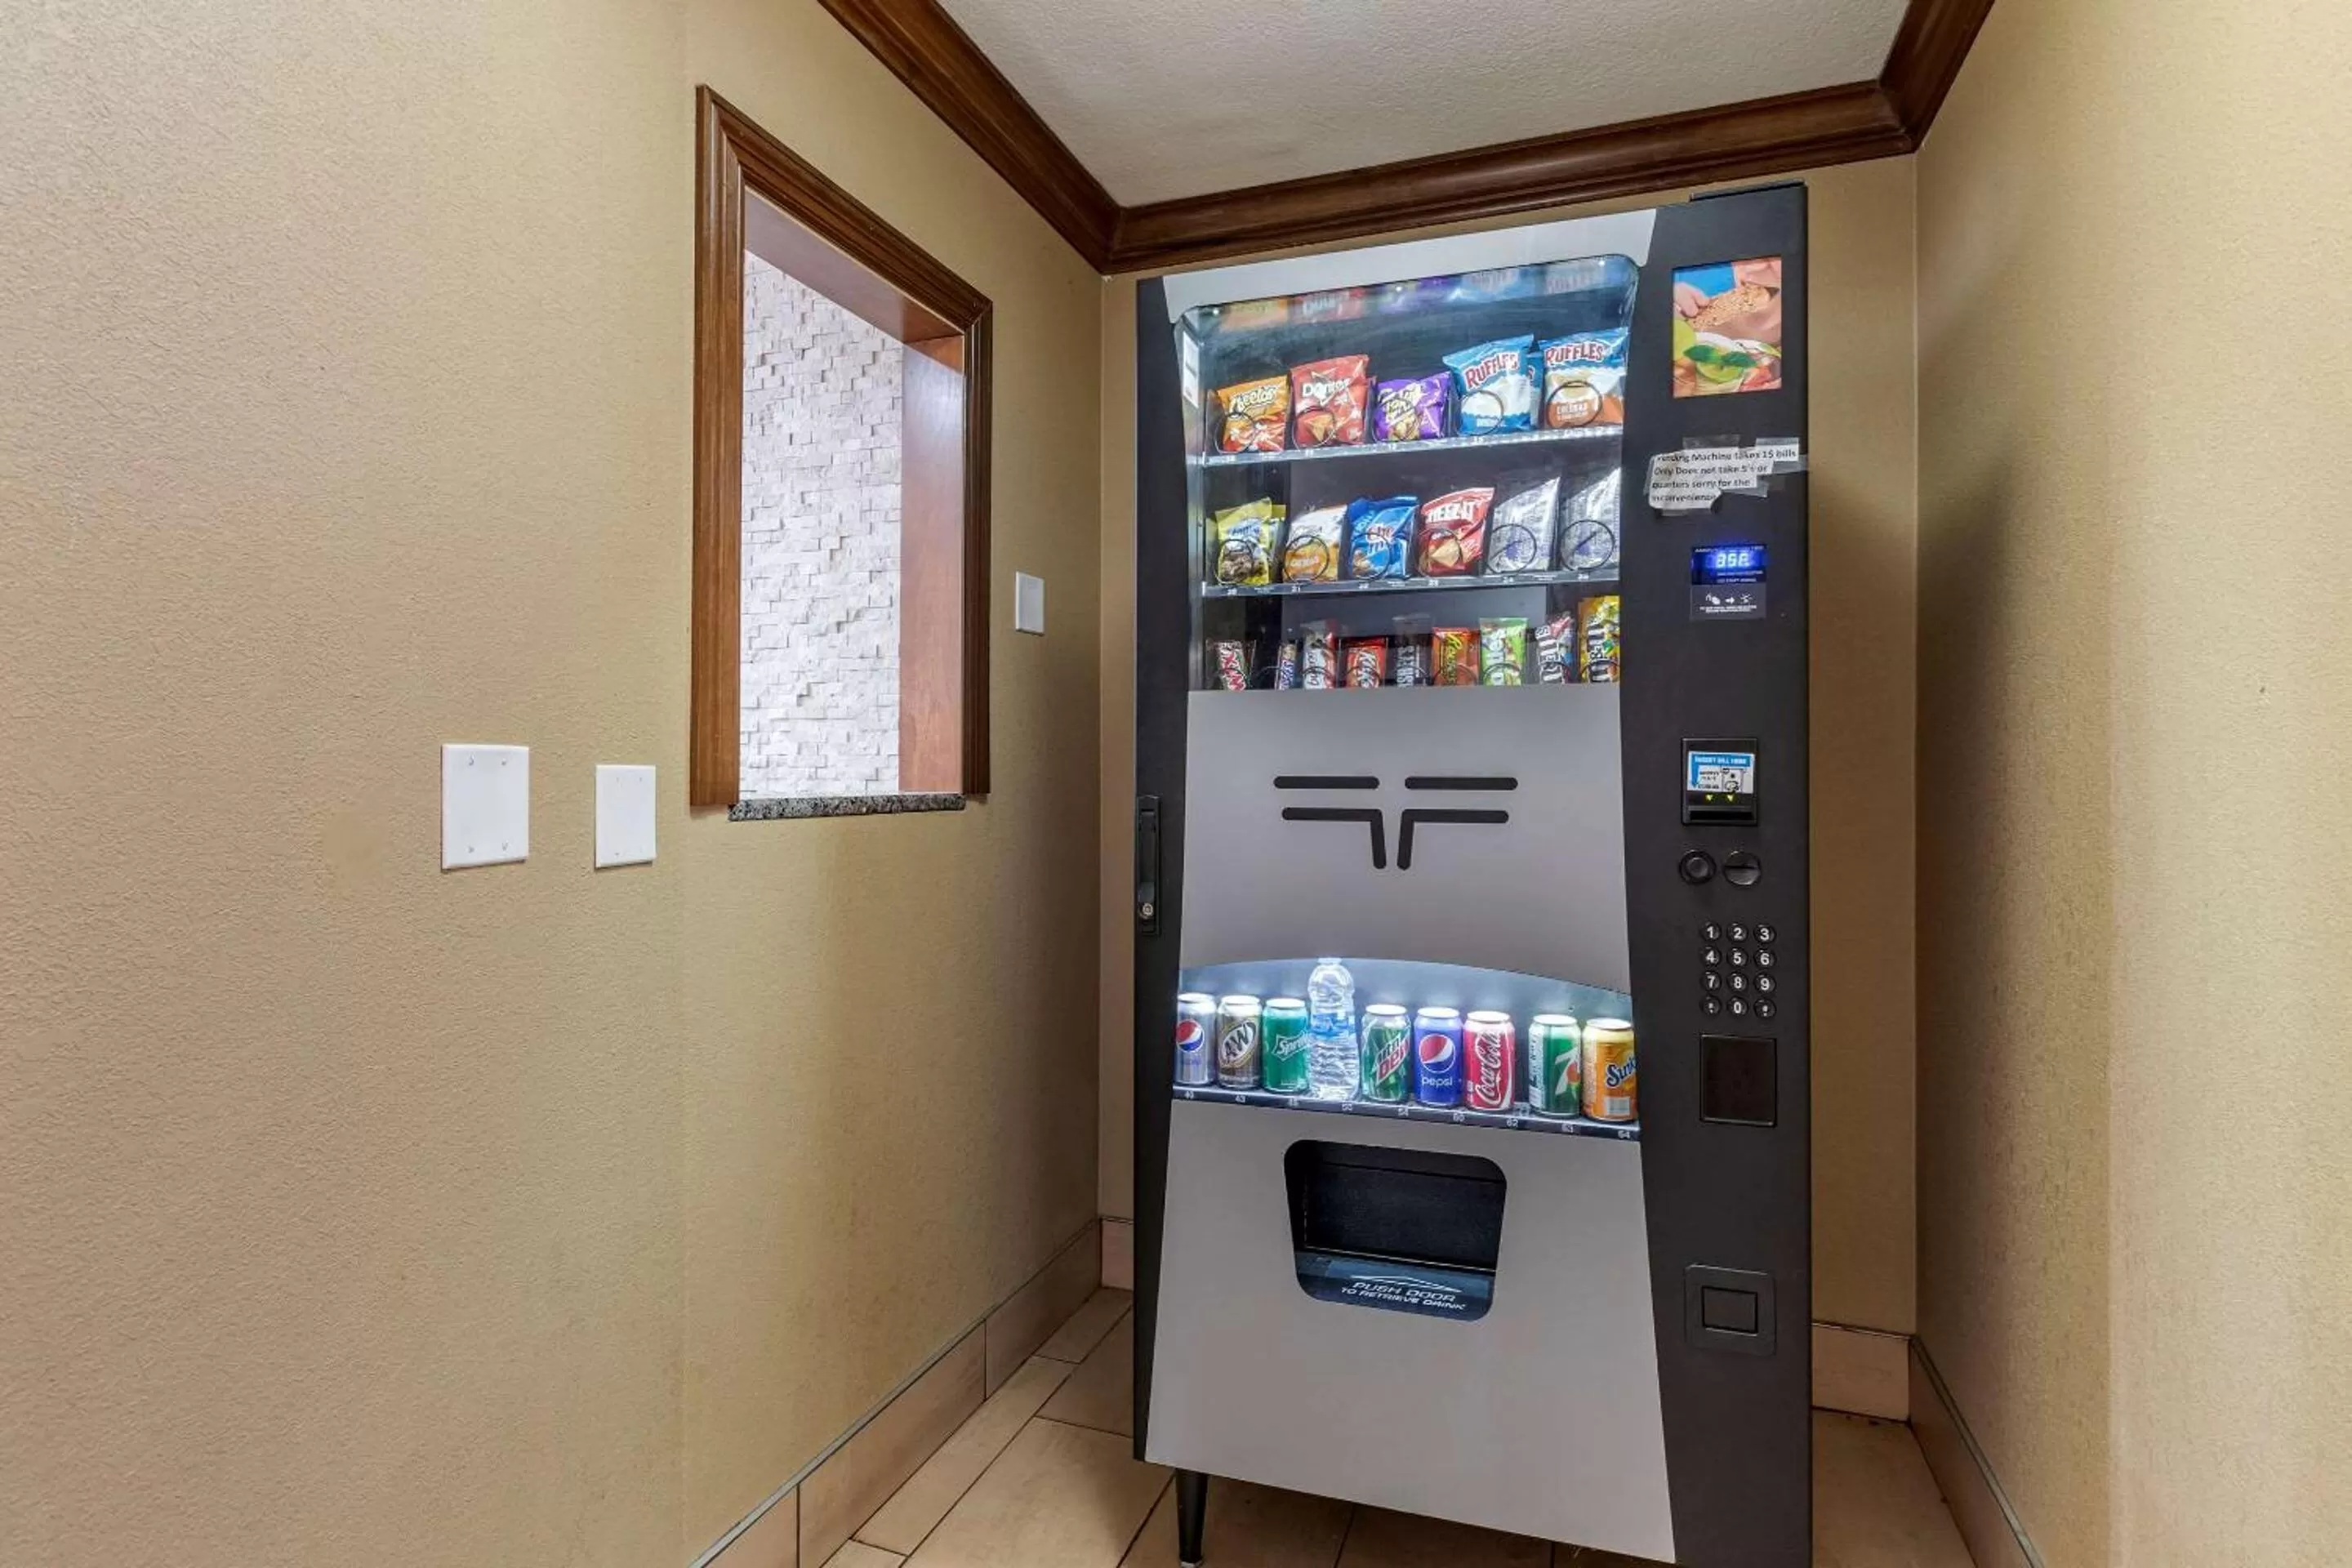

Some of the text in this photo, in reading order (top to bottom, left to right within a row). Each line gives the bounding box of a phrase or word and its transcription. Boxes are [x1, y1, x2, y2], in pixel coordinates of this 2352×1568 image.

[1545, 342, 1605, 366] RUFFLES
[1464, 352, 1519, 390] RUFFLES
[1654, 467, 1673, 476] Only
[1733, 479, 1750, 487] the
[1707, 926, 1769, 941] 1 2 3
[1706, 951, 1769, 964] 4 5 6
[1707, 975, 1770, 990] 7 8 9
[1734, 1001, 1741, 1013] 0
[1422, 1076, 1453, 1088] pepsi
[1352, 1282, 1456, 1302] PUSH DOOR
[1359, 1290, 1419, 1303] RETRIEVE
[1423, 1299, 1465, 1310] DRINK
